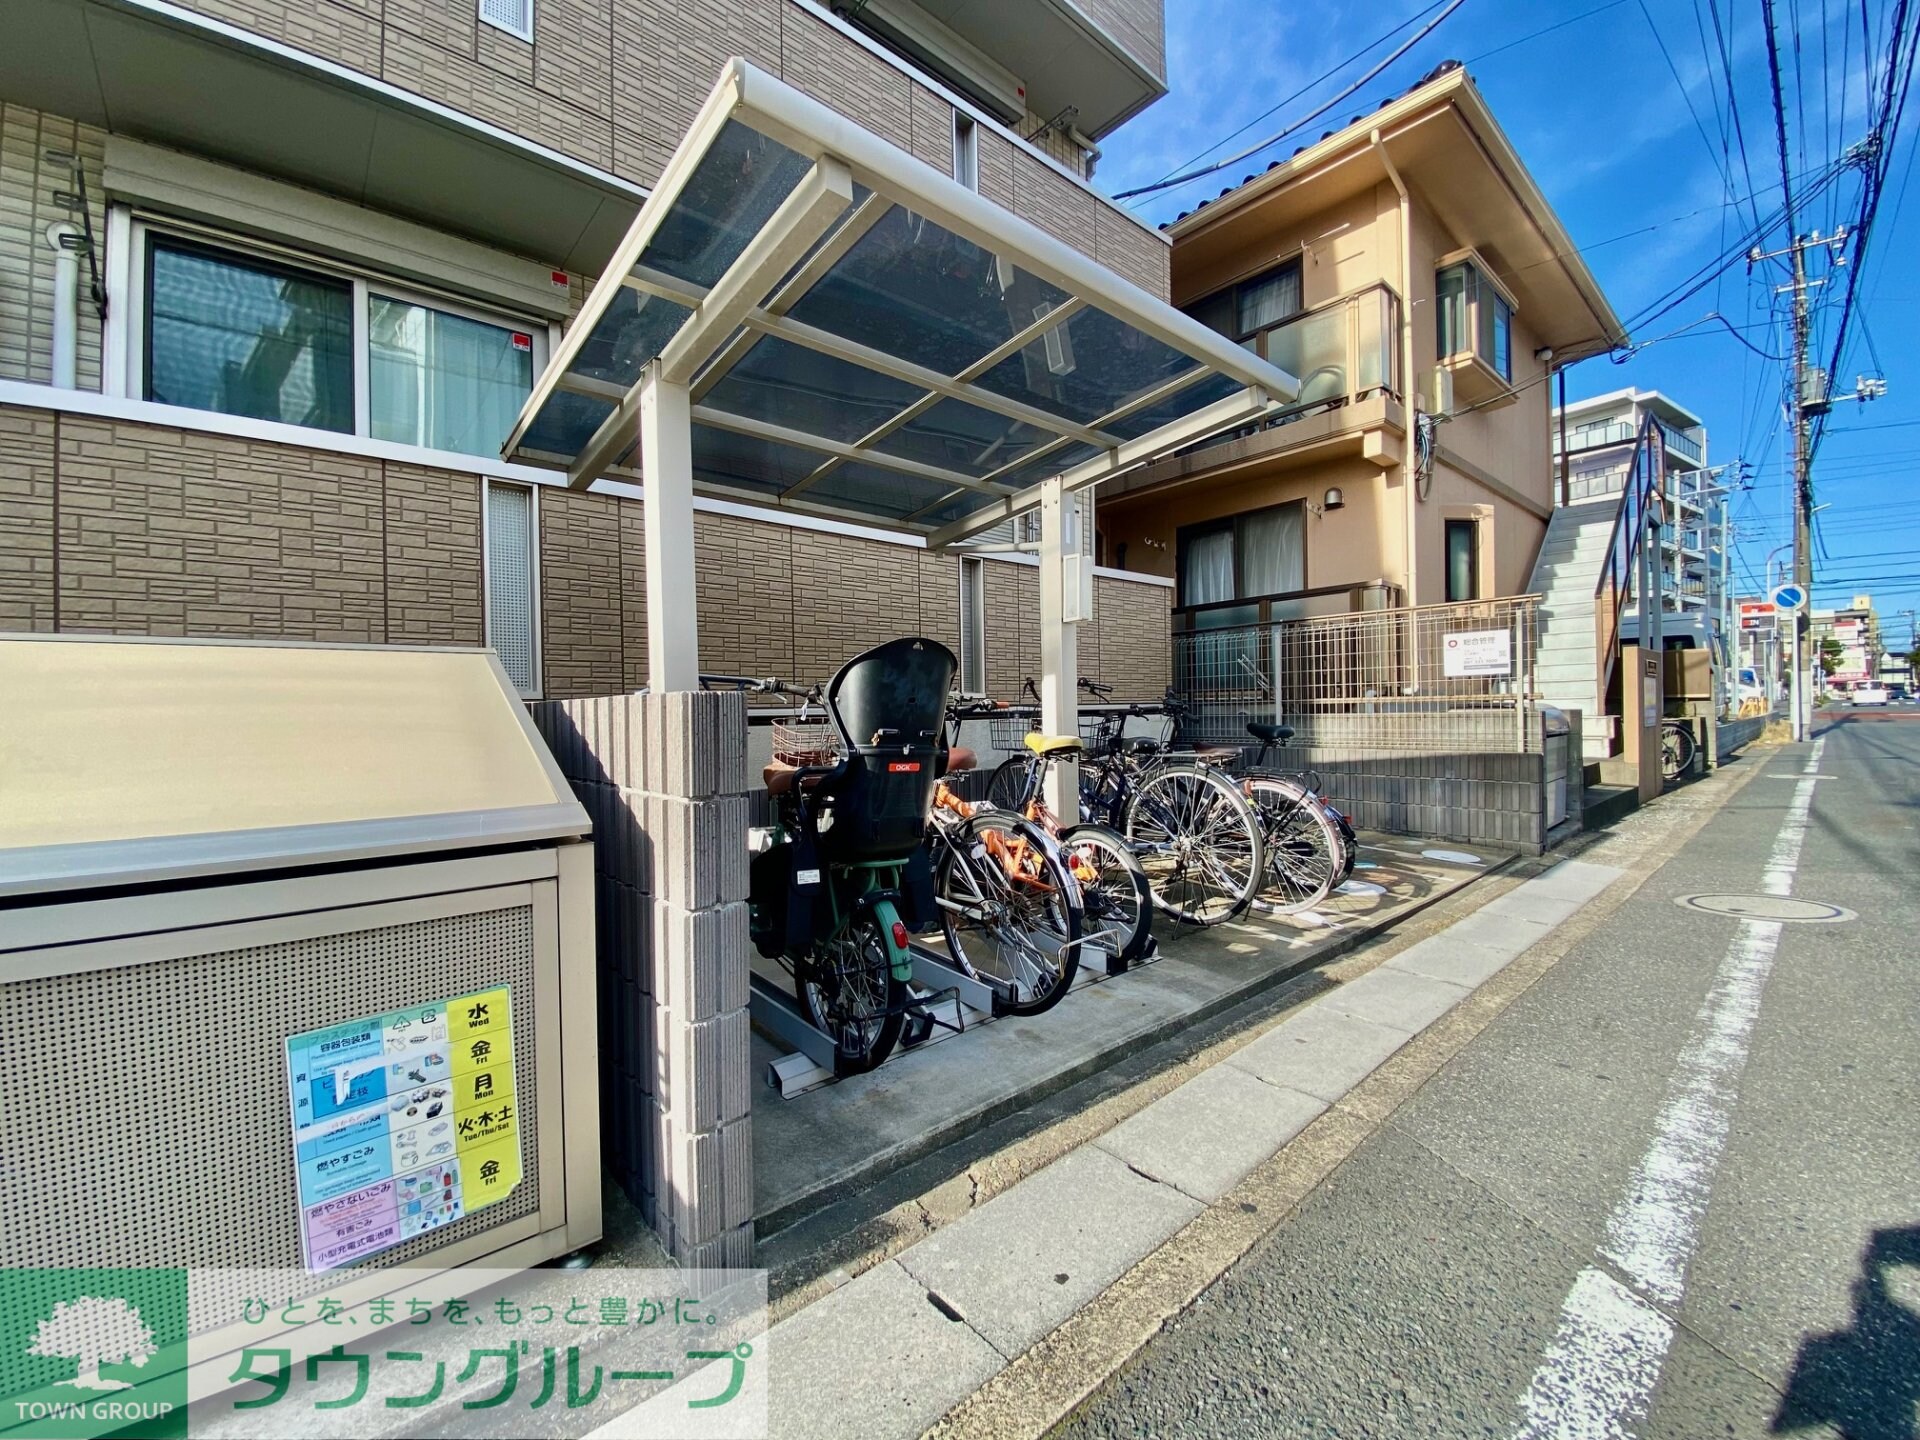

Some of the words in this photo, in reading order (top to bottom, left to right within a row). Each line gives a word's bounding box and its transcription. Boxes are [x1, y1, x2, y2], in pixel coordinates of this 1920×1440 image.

[467, 1003, 489, 1020] 水
[469, 1018, 490, 1029] Wed
[320, 1032, 371, 1053] 容器包装類
[471, 1040, 492, 1059] 金
[476, 1056, 488, 1065] Fri
[474, 1073, 493, 1093] 月
[474, 1089, 494, 1100] Mon
[464, 1122, 510, 1142] Tue/Thu/Sat
[316, 1146, 375, 1173] 燃やすごみ
[479, 1160, 500, 1180] 金
[485, 1175, 497, 1186] Fri
[311, 1182, 391, 1219] 燃やさないごみ
[336, 1219, 373, 1238] 有害ごみ
